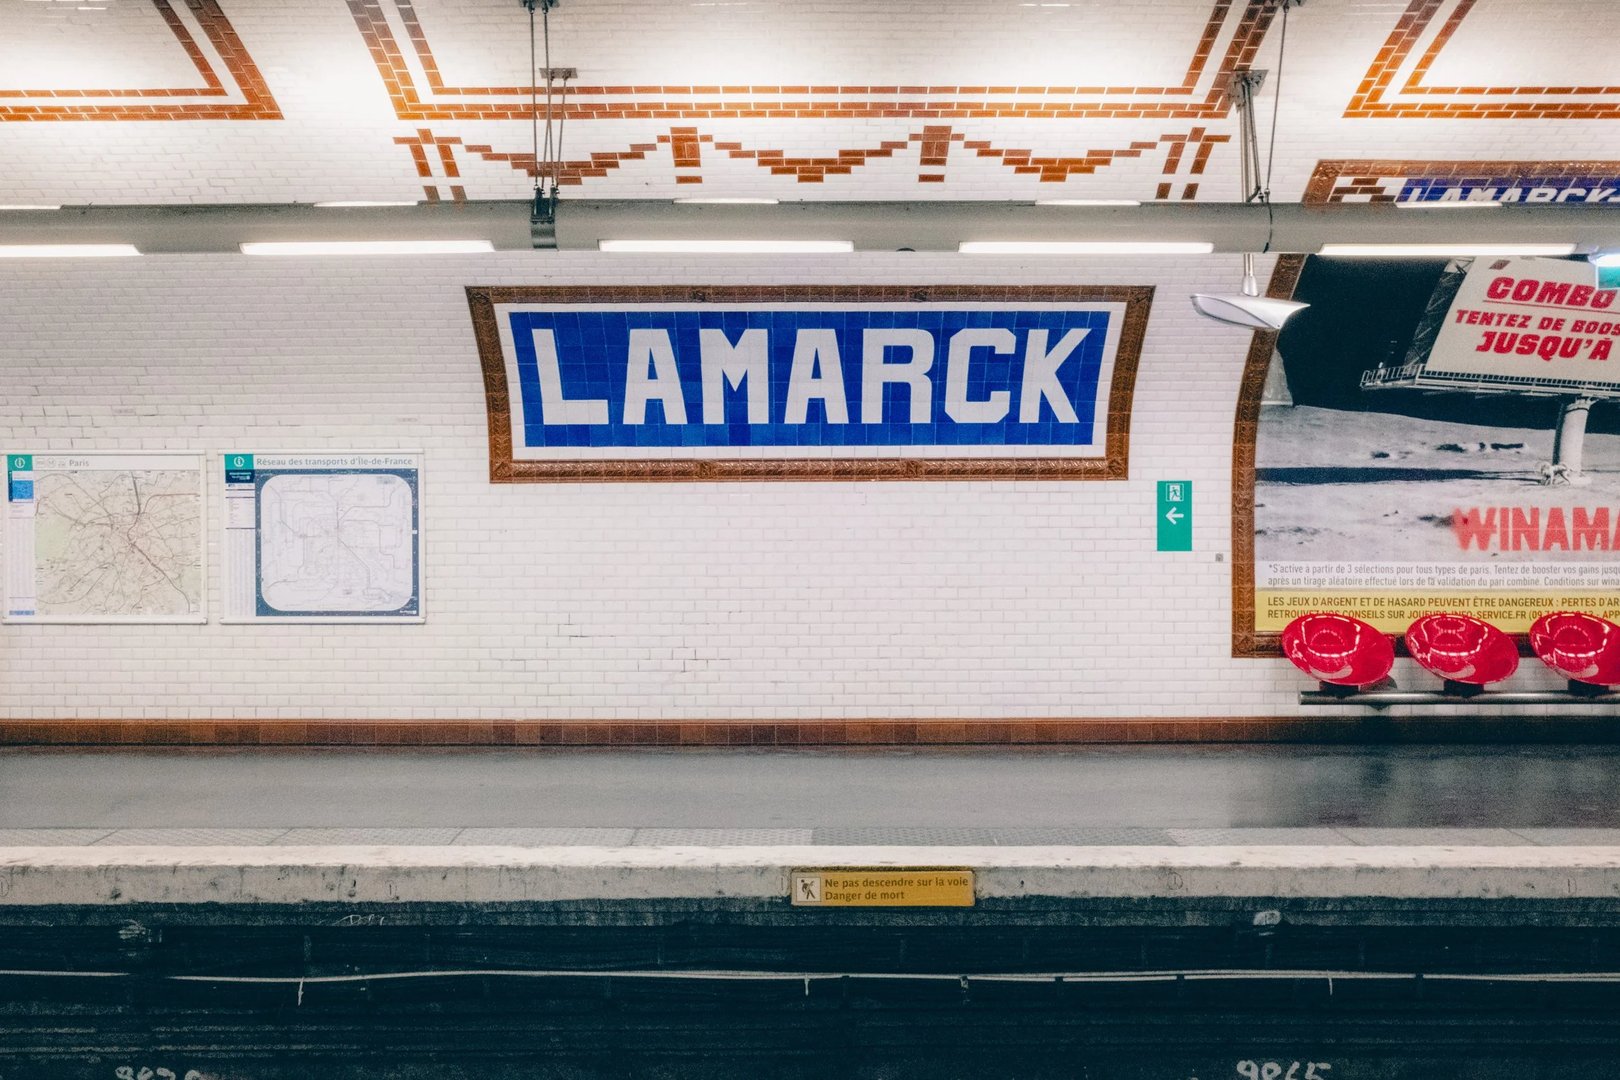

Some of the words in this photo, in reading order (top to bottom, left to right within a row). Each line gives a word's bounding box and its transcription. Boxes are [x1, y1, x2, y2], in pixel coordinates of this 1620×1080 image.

[1487, 276, 1617, 309] COMBO
[1455, 309, 1532, 328] TENTEZ
[1538, 317, 1566, 331] DE
[1475, 330, 1613, 361] JUSQU'À
[532, 328, 1092, 425] LAMARCK
[69, 459, 90, 467] Paris
[256, 457, 286, 466] Réseau
[288, 457, 303, 466] des
[305, 457, 348, 467] transports
[350, 455, 413, 466] d'Île-de-France
[1312, 564, 1334, 576] partir
[1335, 564, 1345, 574] de
[1347, 564, 1352, 574] 3
[1354, 564, 1394, 574] sélections
[1396, 566, 1414, 576] pour
[1416, 565, 1433, 574] tous
[1435, 565, 1456, 576] types
[1458, 565, 1468, 575] de
[1494, 565, 1519, 575] Tentez
[1521, 565, 1530, 575] de
[1532, 565, 1561, 575] booster
[1563, 566, 1577, 574] vos
[1578, 566, 1600, 576] gains
[1268, 576, 1290, 587] après
[1291, 578, 1302, 586] un
[1303, 576, 1326, 587] tirage
[1328, 576, 1363, 586] aléatoire
[1365, 576, 1397, 586] effectué
[1399, 576, 1414, 586] lors
[1416, 576, 1426, 586] de
[1437, 577, 1476, 586] validation
[1477, 577, 1488, 586] du
[1489, 577, 1505, 588] pari
[1543, 577, 1585, 587] Conditions
[1587, 578, 1599, 586] sur
[1268, 597, 1285, 607] LES
[1286, 597, 1310, 607] JEUX
[1312, 597, 1358, 607] D'ARGENT
[1360, 597, 1371, 607] ET
[1374, 597, 1385, 607] DE
[1387, 597, 1426, 607] HASARD
[1428, 597, 1470, 607] PEUVENT
[1473, 595, 1496, 607] ÊTRE
[1498, 597, 1554, 607] DANGEREUX
[1561, 597, 1597, 607] PERTES
[1342, 609, 1385, 619] CONSEILS
[1387, 610, 1405, 619] SUR
[825, 879, 839, 888] Ne
[842, 880, 860, 889] pas
[862, 877, 914, 888] descendre
[917, 879, 932, 887] sur
[935, 877, 945, 887] la
[947, 877, 969, 886] voie
[825, 891, 861, 902] Danger
[865, 891, 877, 900] de
[880, 891, 905, 900] mort
